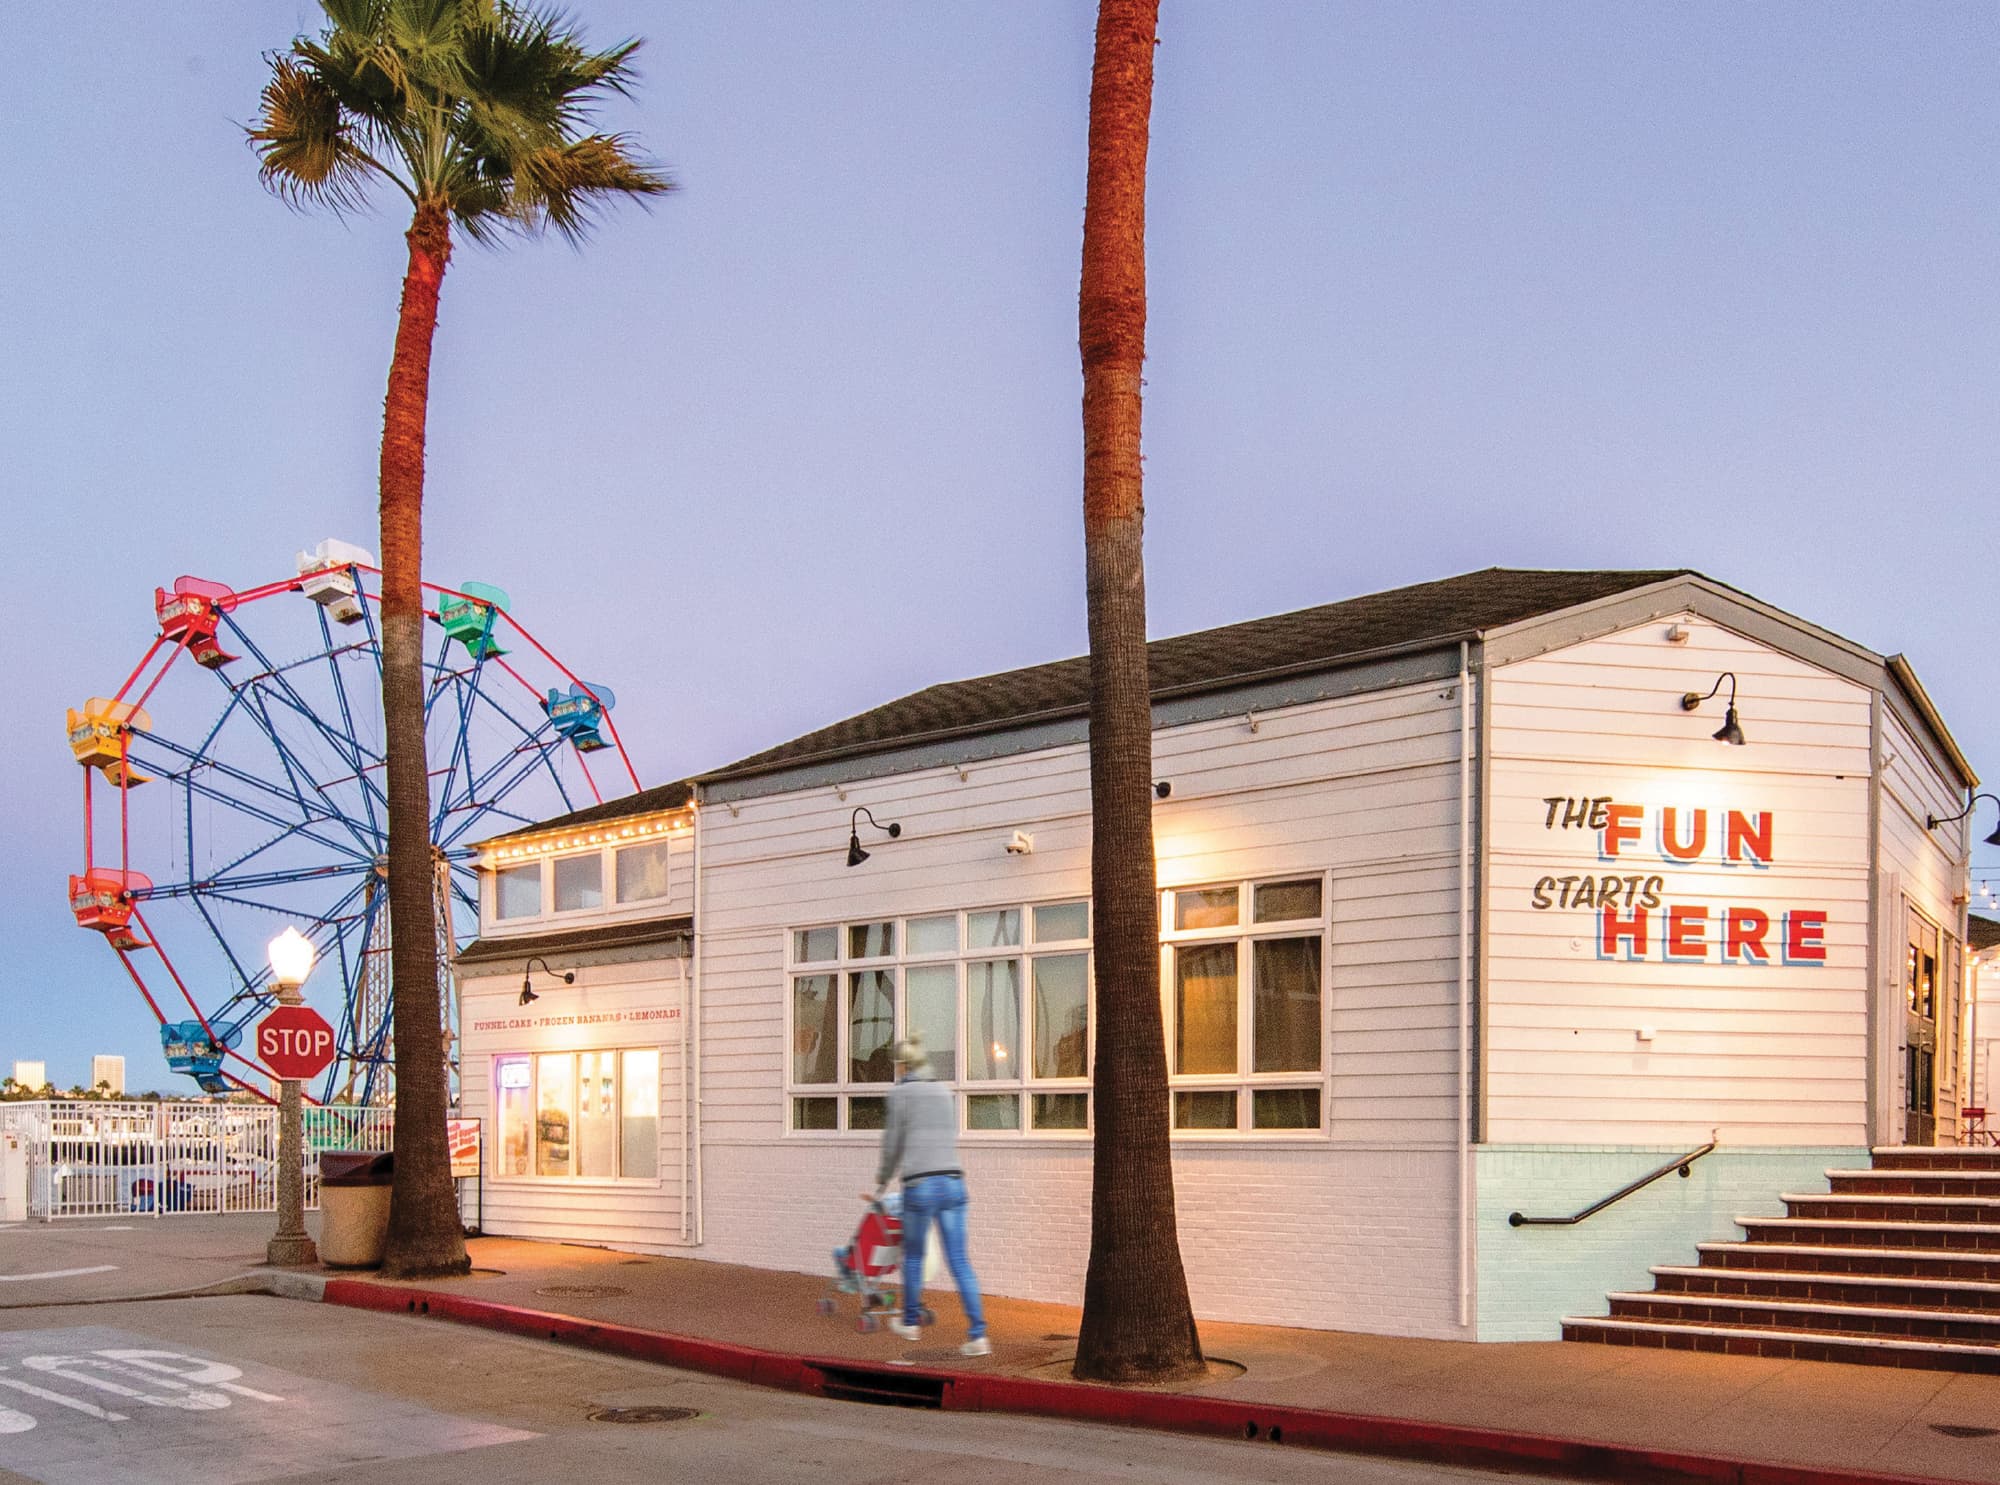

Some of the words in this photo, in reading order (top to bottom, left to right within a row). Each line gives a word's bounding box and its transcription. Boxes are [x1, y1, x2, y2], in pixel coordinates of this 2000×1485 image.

[1543, 797, 1613, 829] THE
[1598, 804, 1773, 869] FUN
[1531, 875, 1663, 910] STARTS
[1596, 903, 1827, 967] HERE
[474, 1021, 507, 1030] FUNNEL
[509, 1019, 532, 1029] CAKE
[540, 1016, 574, 1026] FROZEN
[577, 1013, 622, 1024] BANANAS
[629, 1009, 681, 1020] LEMONADE
[262, 1028, 330, 1057] STOP
